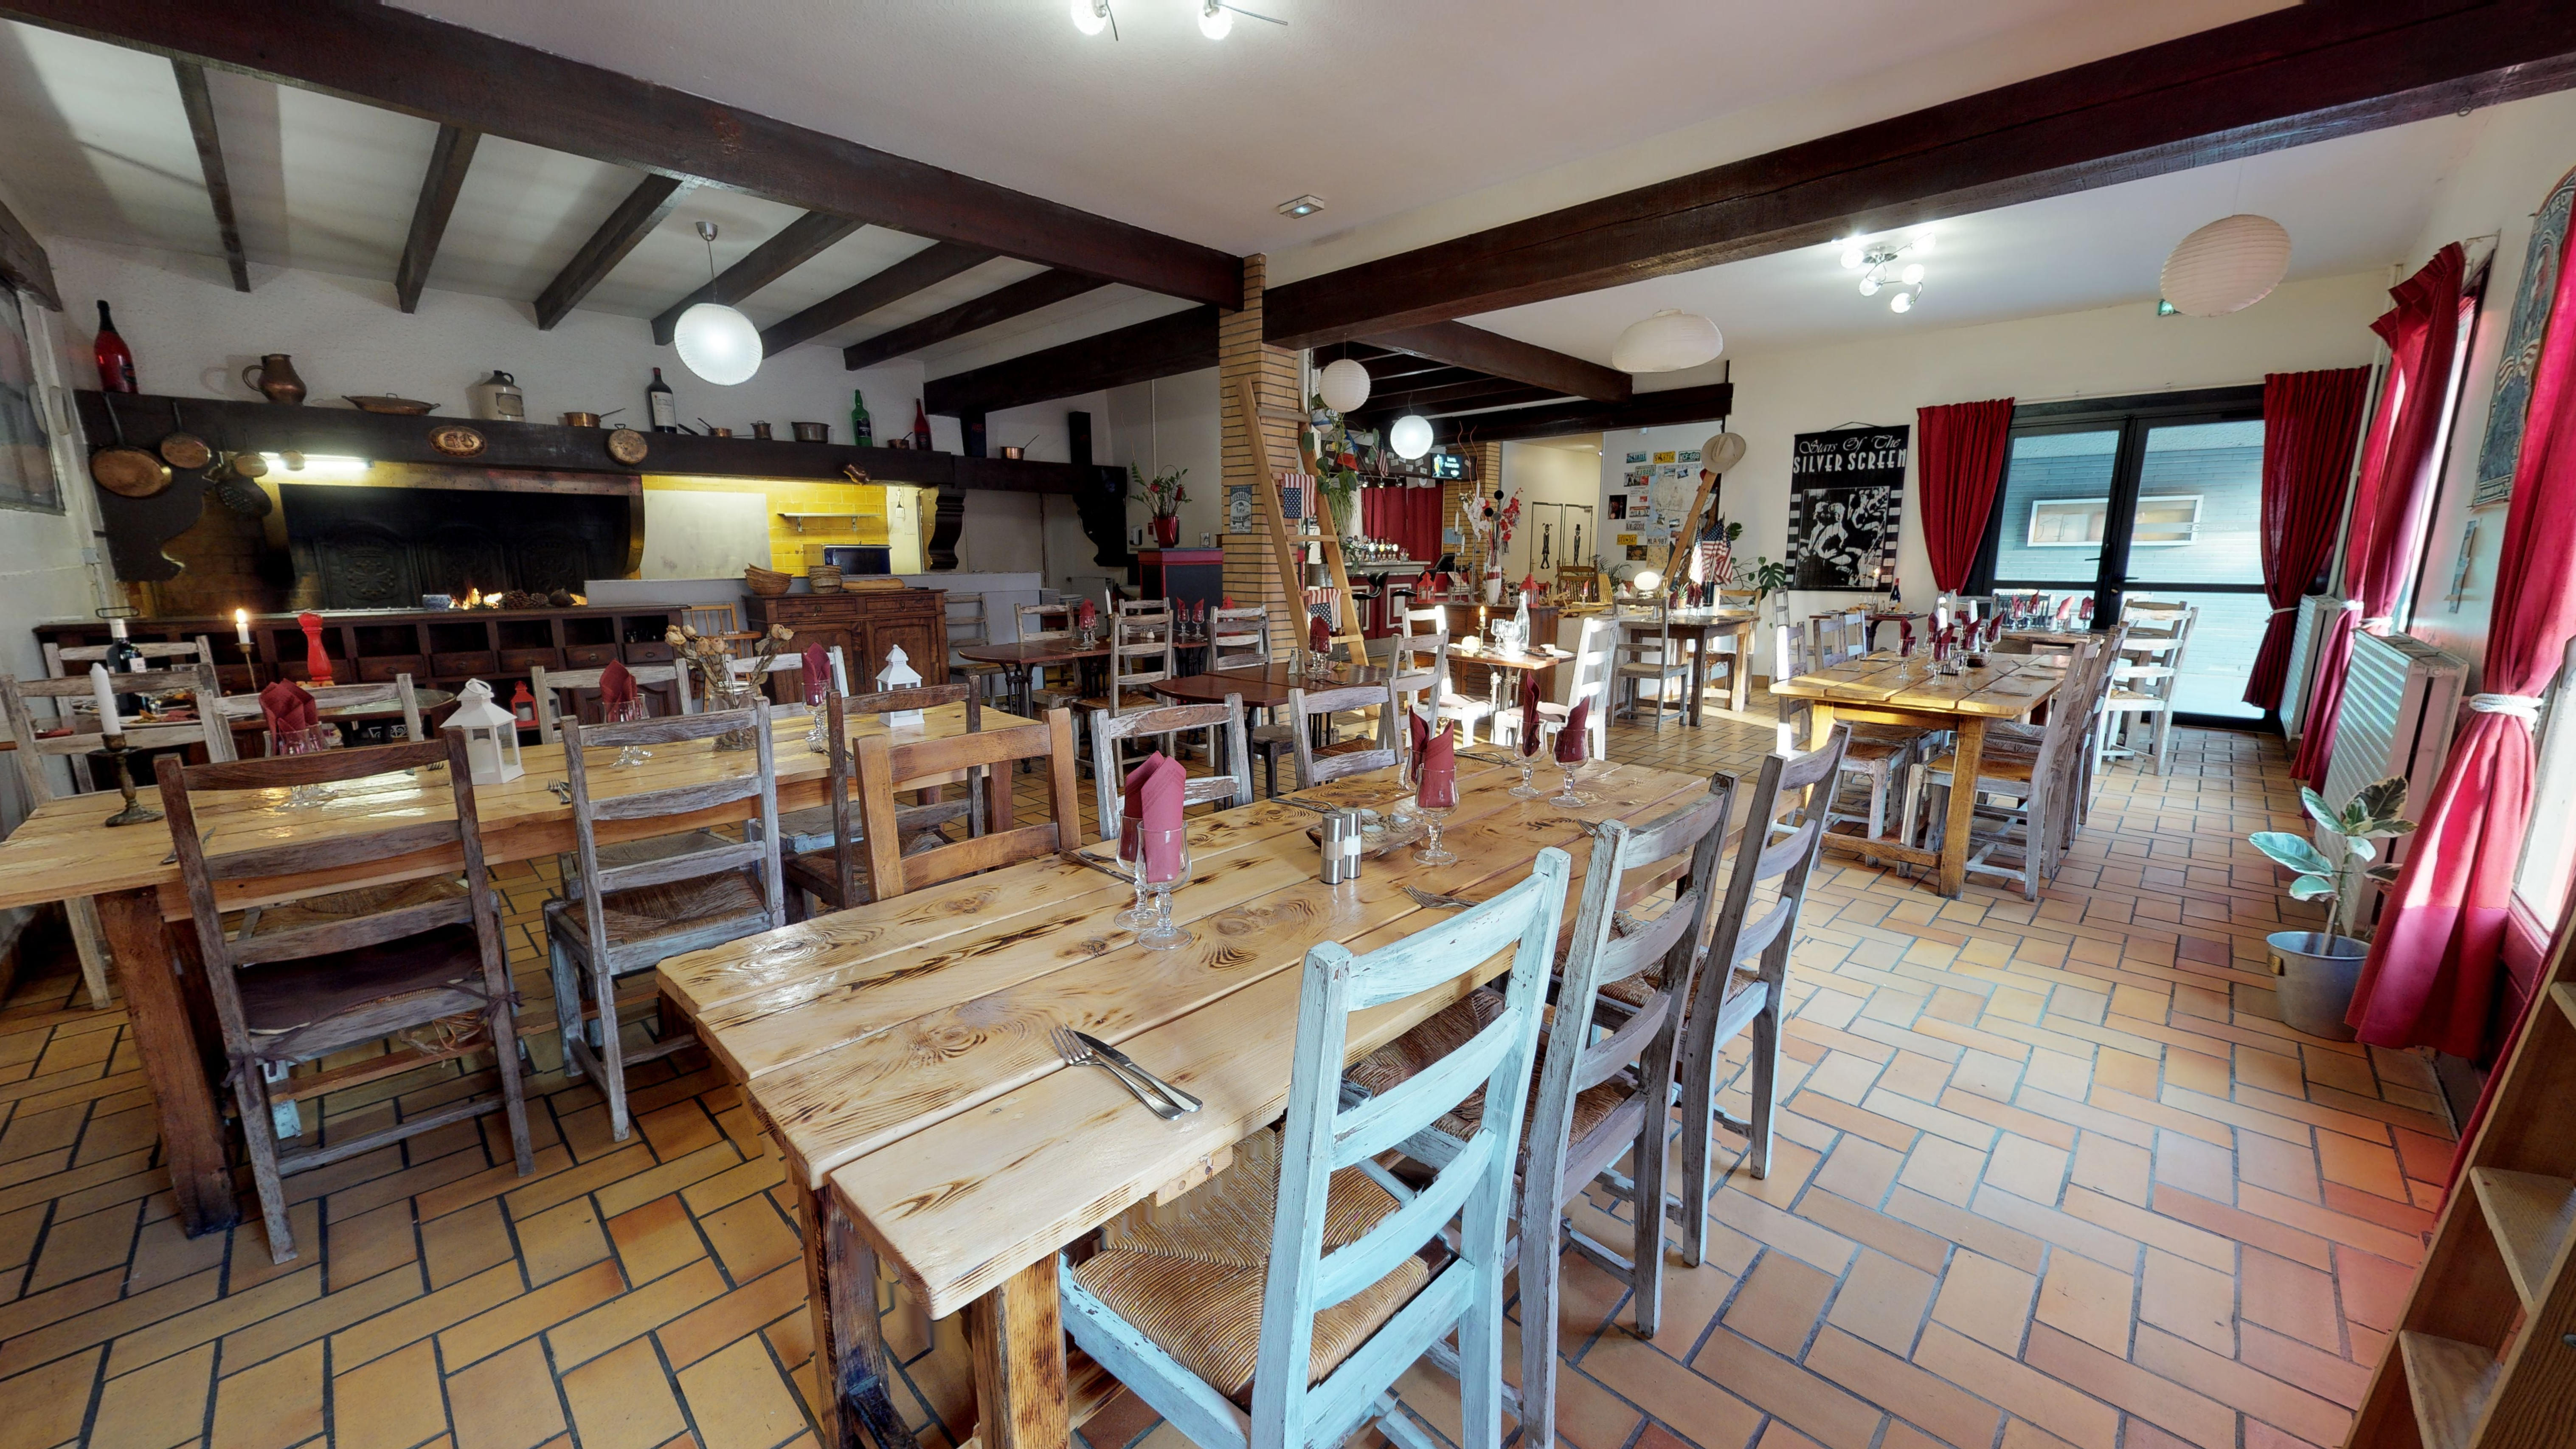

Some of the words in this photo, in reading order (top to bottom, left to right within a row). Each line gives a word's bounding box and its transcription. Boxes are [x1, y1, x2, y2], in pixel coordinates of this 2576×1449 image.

[1799, 439, 1838, 454] Stars
[1843, 436, 1867, 453] Of
[1871, 435, 1901, 449] The
[1793, 454, 1843, 474] SILVER
[1848, 449, 1907, 471] SCREEN
[1230, 491, 1251, 504] MUSTANG
